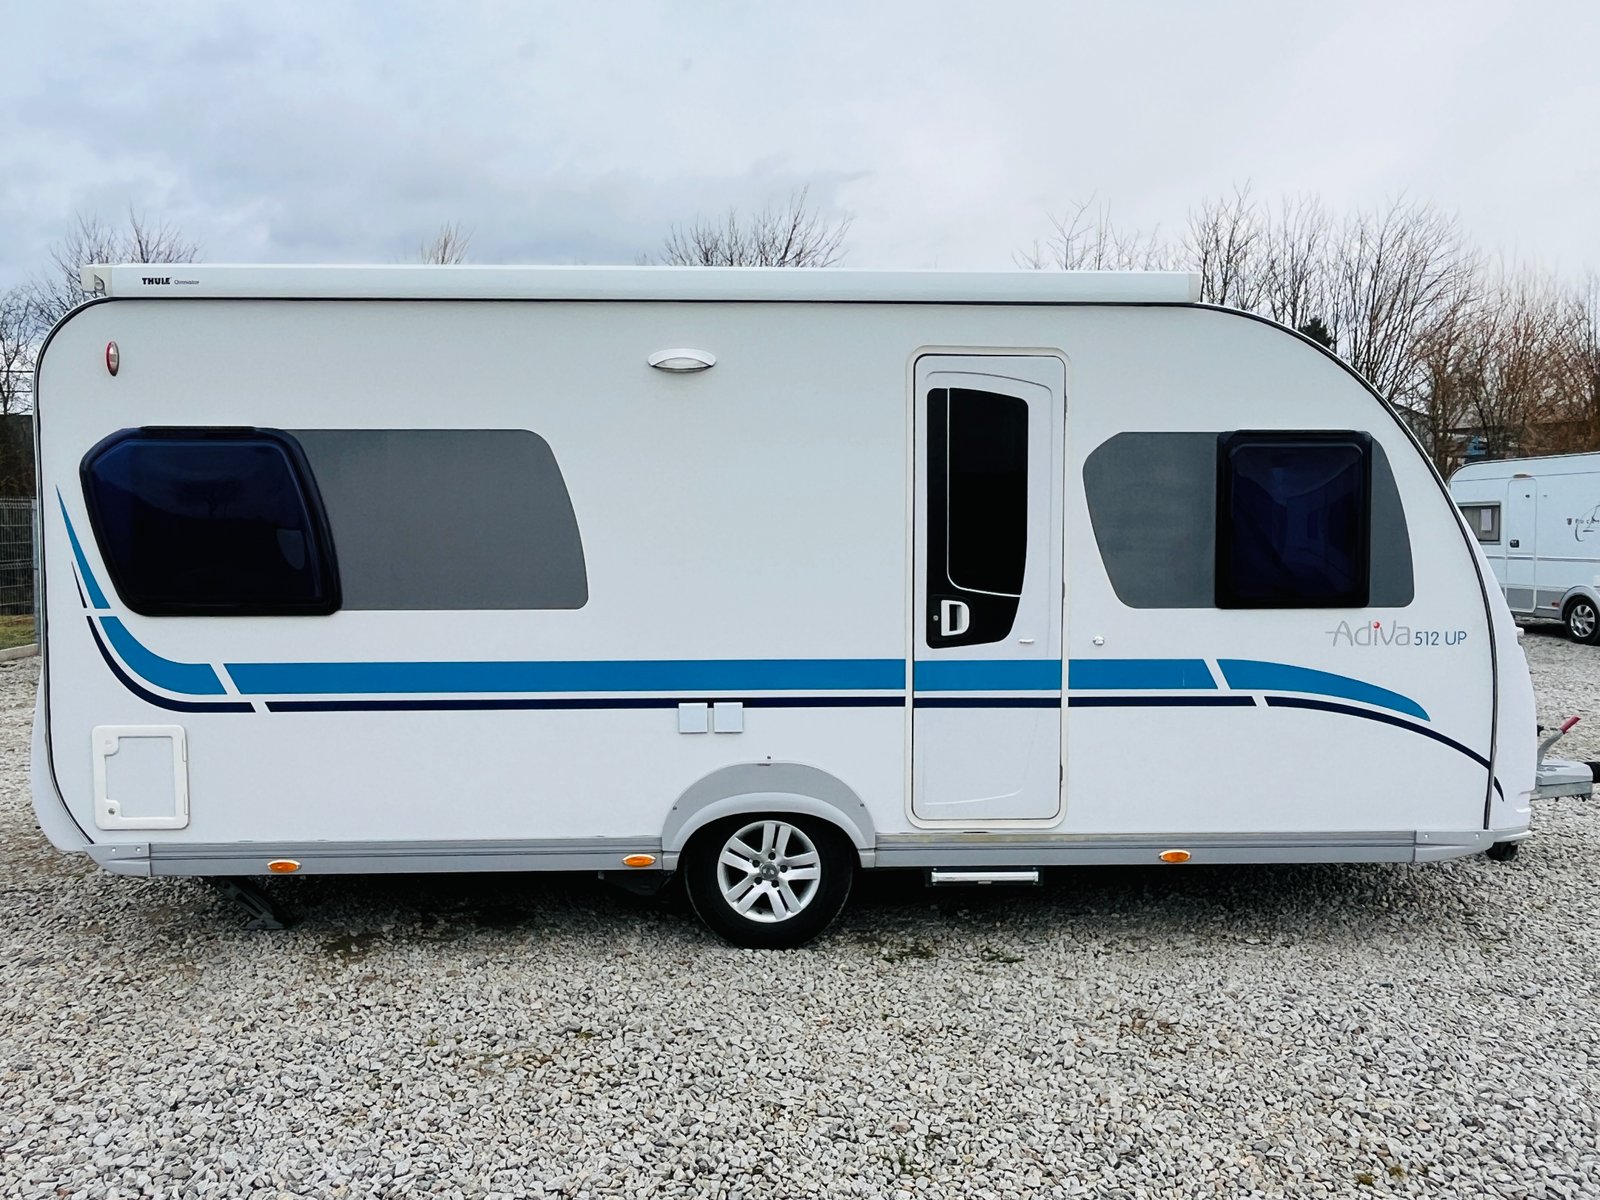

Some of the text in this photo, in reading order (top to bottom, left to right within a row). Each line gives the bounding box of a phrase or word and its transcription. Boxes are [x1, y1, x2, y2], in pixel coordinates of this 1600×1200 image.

[141, 277, 171, 285] THULE
[1325, 620, 1468, 647] AdiVa 512 UP
